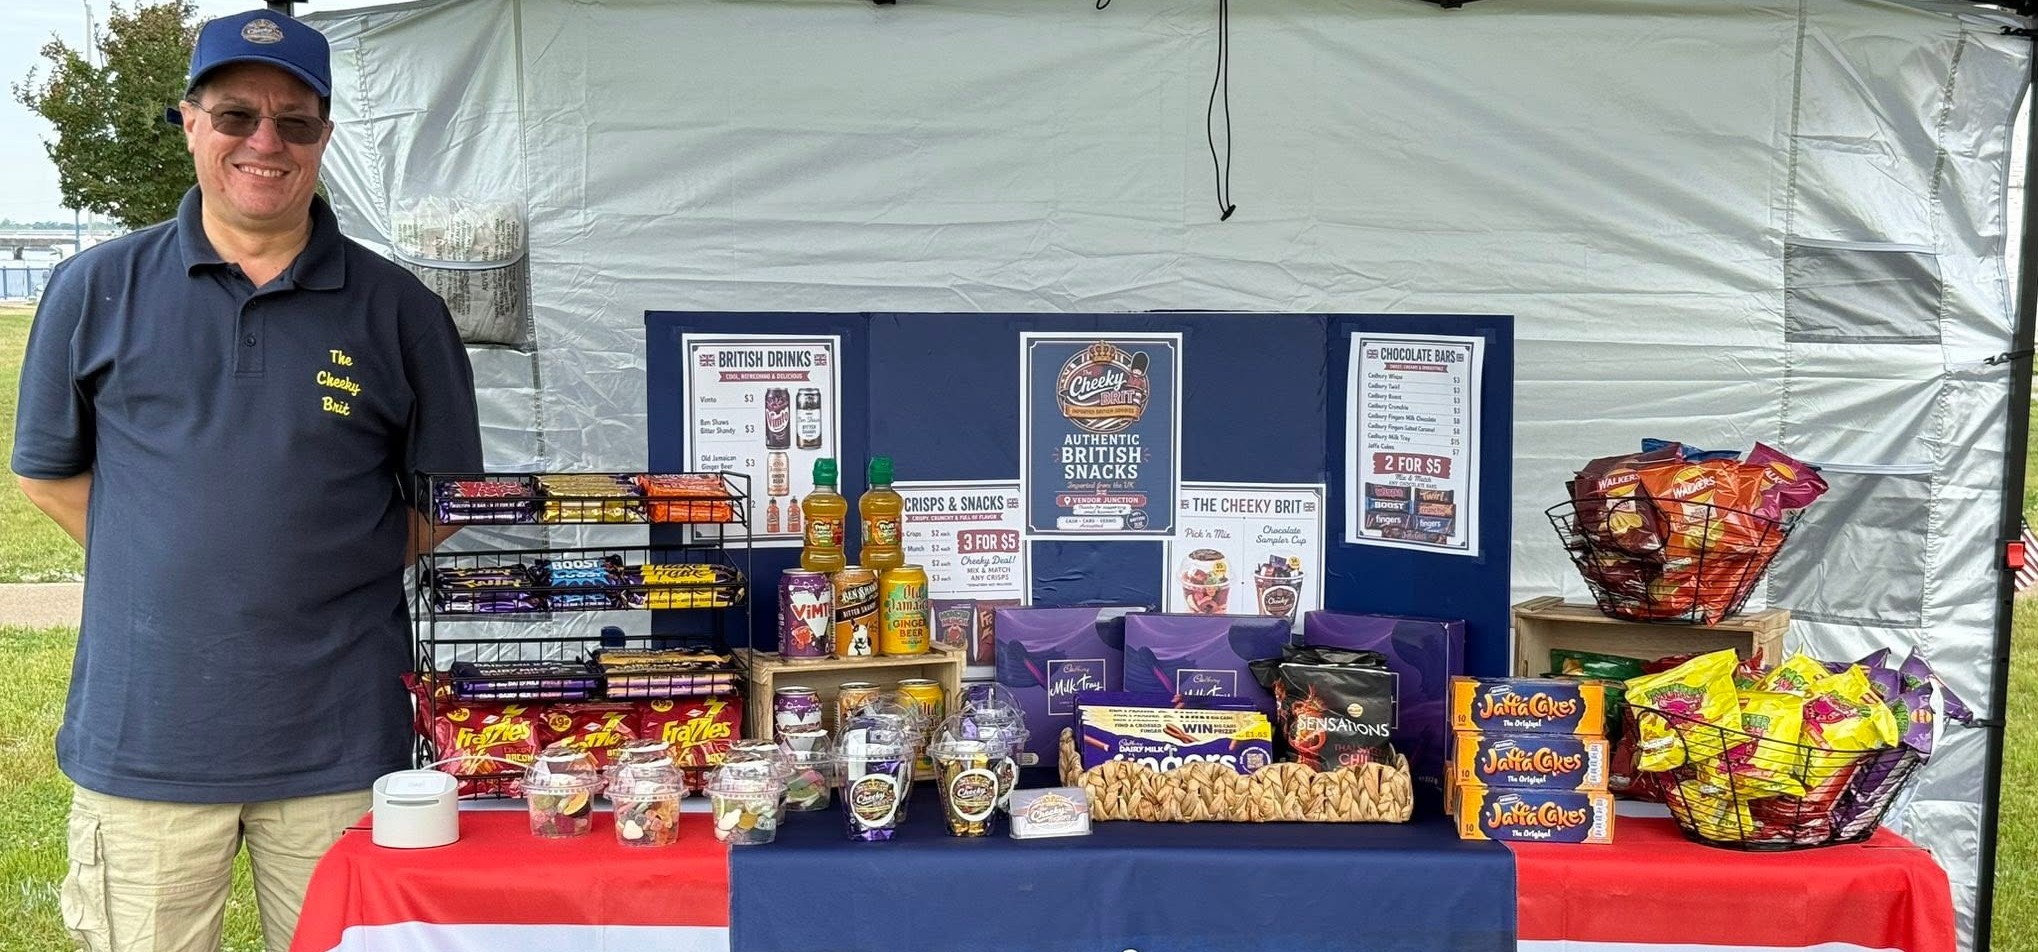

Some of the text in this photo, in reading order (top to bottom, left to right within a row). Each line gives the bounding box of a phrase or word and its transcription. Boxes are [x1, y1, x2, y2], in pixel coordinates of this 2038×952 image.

[329, 349, 354, 366] The
[718, 350, 812, 368] BRITISH DRINKS
[1380, 347, 1456, 363] CHOCOLATE BARS
[1367, 372, 1387, 380] Cadbury
[316, 370, 361, 397] Cheeky
[1069, 369, 1128, 398] Cheeky
[1367, 382, 1387, 390] Cadbury
[744, 394, 754, 403] $3
[1100, 389, 1136, 406] BRIT
[1367, 392, 1387, 400] Cadbury
[321, 396, 351, 416] Brit
[1367, 402, 1387, 410] Cadbury
[1367, 412, 1387, 420] Cadbury
[1388, 413, 1405, 421] Fingers
[700, 427, 736, 436] Bitter Shandy
[744, 424, 755, 434] $3
[1367, 422, 1387, 430] Cadbury
[1388, 423, 1404, 431] Fingers
[1064, 433, 1140, 446] AUTHENTIC
[1367, 432, 1387, 440] Cadbury
[1400, 434, 1411, 442] Tray
[1061, 447, 1142, 463] BRITISH
[1452, 448, 1459, 456] $7
[700, 454, 737, 463] Old Jamaican
[745, 458, 756, 467] $3
[701, 463, 719, 471] Ginger
[1384, 455, 1442, 474] 2 FOR $5
[1064, 464, 1138, 480] SNACKS
[1067, 481, 1135, 490] Imported from the UK
[904, 495, 1004, 512] CRISPS & SNACKS
[1192, 497, 1302, 514] THE CHEEKY BRIT
[1374, 501, 1405, 509] BOOST
[1375, 514, 1402, 525] fingers
[905, 530, 922, 538] Crisps
[931, 529, 940, 537] $2
[1184, 527, 1203, 539] Pick
[1213, 529, 1232, 539] Mix
[1262, 524, 1302, 535] Chocolate
[963, 532, 1016, 551] 3 FOR $5
[1255, 535, 1307, 546] Sampler Cup
[931, 544, 940, 553] $2
[551, 559, 599, 571] BOOST
[931, 559, 940, 567] $2
[960, 555, 1017, 567] Cheeky Deal!
[931, 574, 940, 582] $3
[903, 584, 924, 599] Old
[842, 608, 861, 618] BITTER
[899, 628, 924, 637] BEER
[1050, 673, 1104, 697] Milk Tray
[1477, 691, 1577, 721] Jaffa Cakes
[551, 716, 572, 727] 49p
[1457, 714, 1467, 722] 10
[1503, 718, 1542, 729] The Original
[661, 717, 732, 747] Frazzles
[1182, 723, 1213, 735] WIN
[1297, 716, 1391, 737] SENSATIONS
[455, 715, 531, 750] Frazzles
[1481, 746, 1534, 775] Jaffa
[1534, 747, 1582, 776] Cakes
[1461, 770, 1470, 778] 10
[1507, 774, 1547, 785] The Original
[1486, 801, 1587, 830] Jaffa Cakes
[1465, 823, 1474, 832] 10
[1512, 828, 1551, 840] The Original
